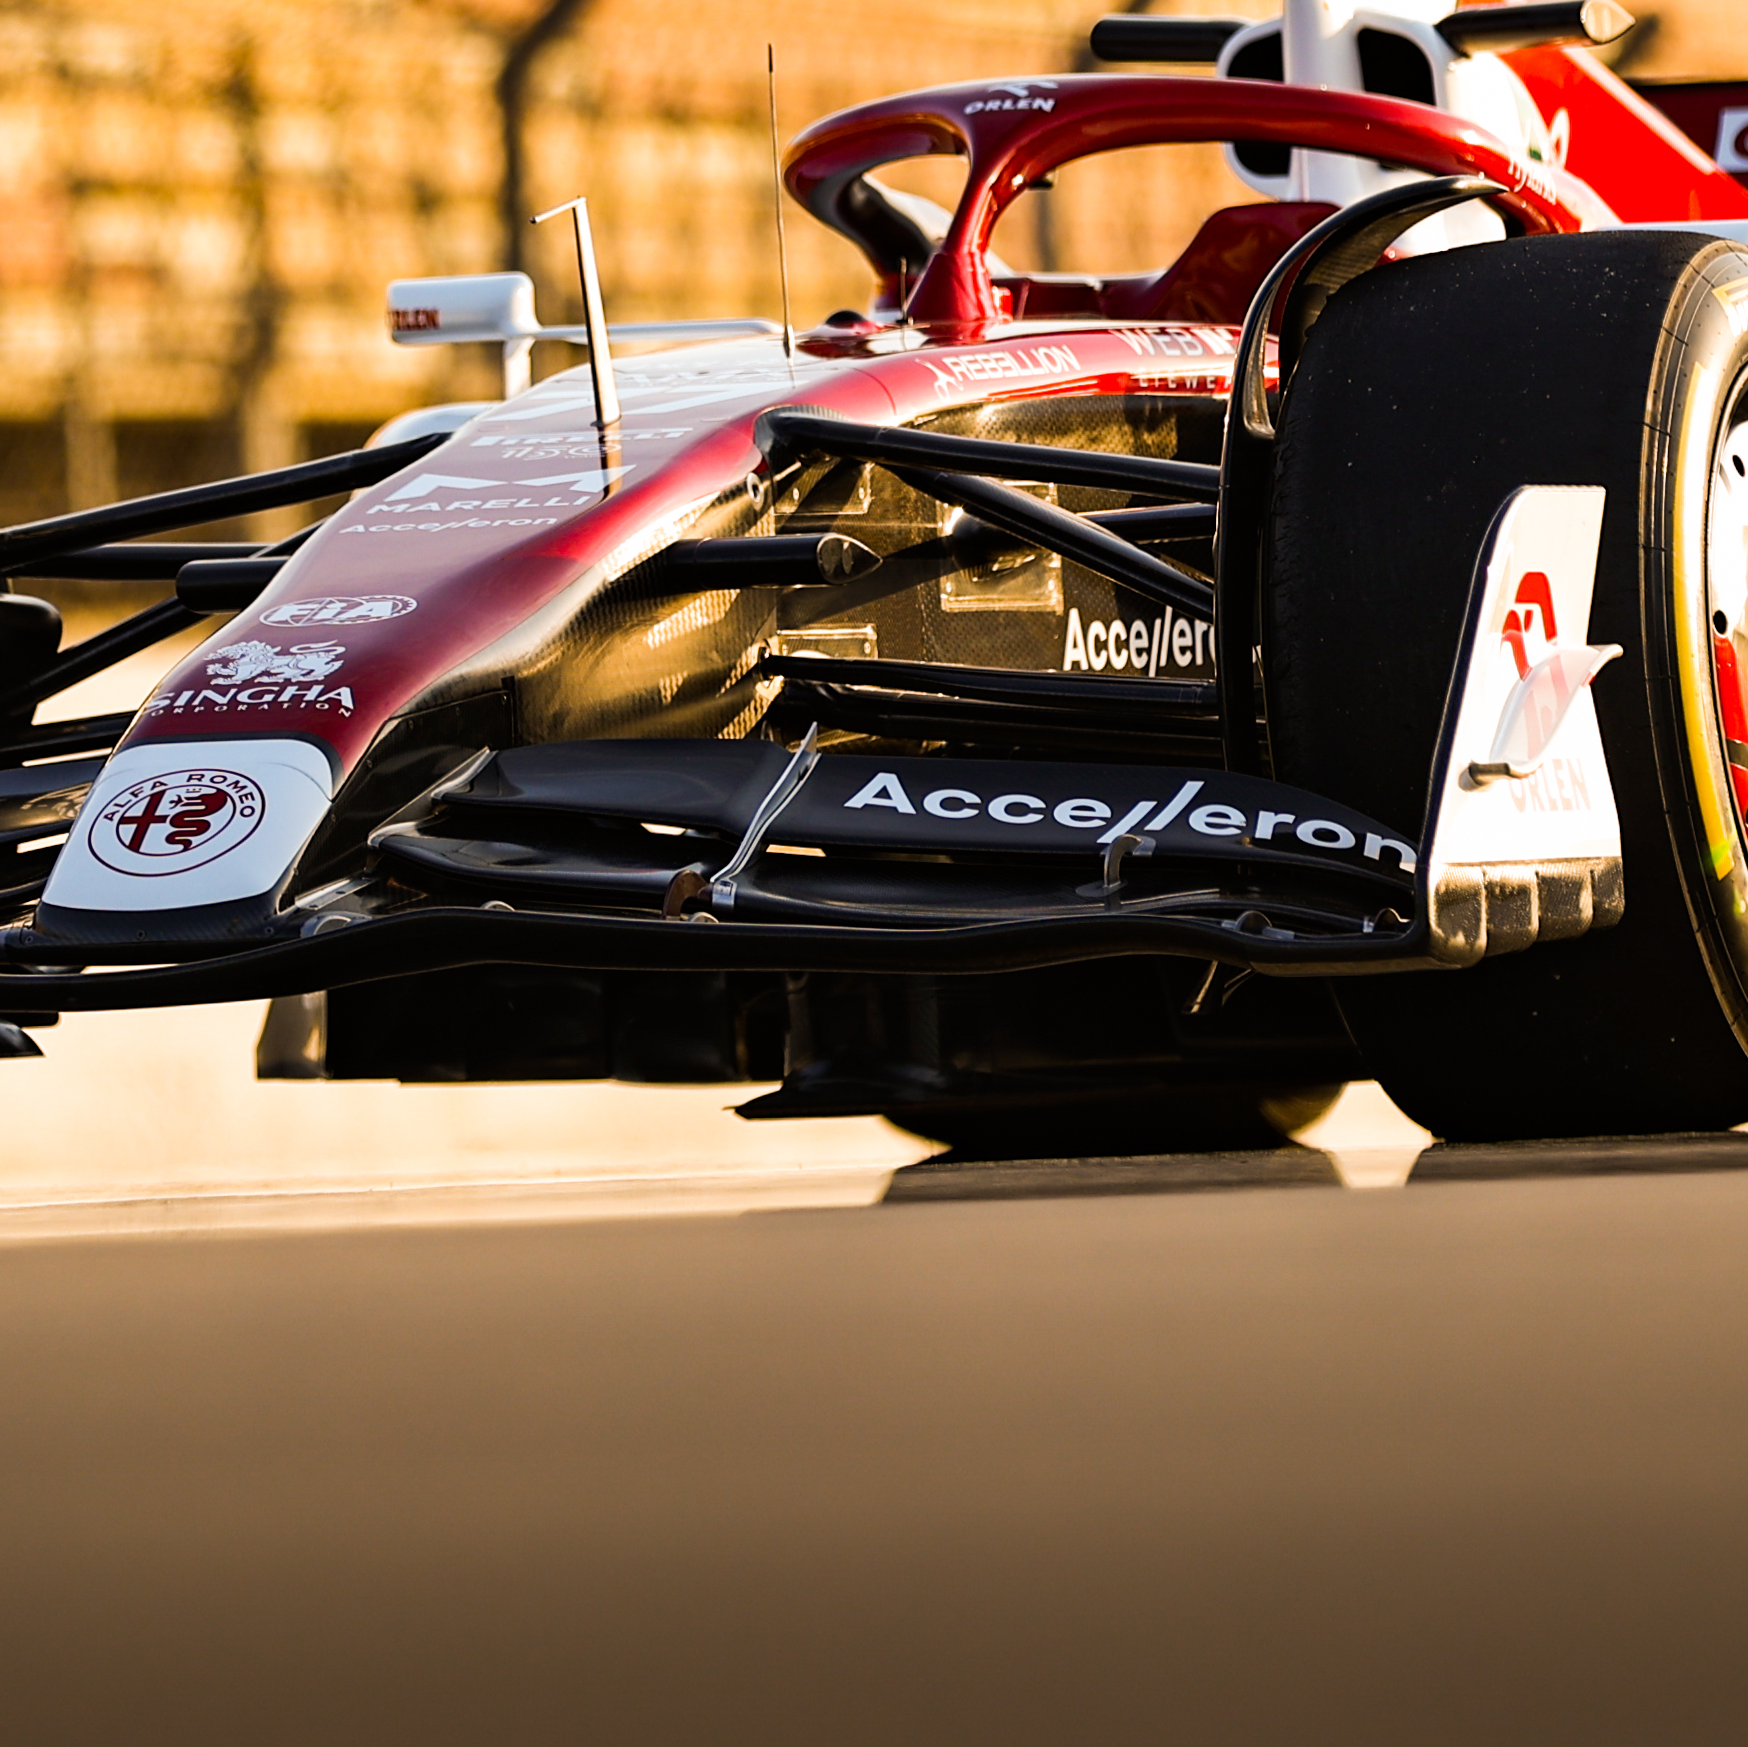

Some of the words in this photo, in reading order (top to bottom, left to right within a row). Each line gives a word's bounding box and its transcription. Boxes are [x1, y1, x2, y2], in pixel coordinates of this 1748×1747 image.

[962, 96, 1056, 115] ORLEN
[1107, 328, 1204, 356] WEB
[365, 495, 591, 515] MARELLI
[1063, 605, 1216, 678] Acceller
[142, 684, 355, 714] SINGHA
[149, 702, 353, 719] ORPORATION
[102, 780, 169, 823] ALFA
[185, 773, 257, 819] ROMEO
